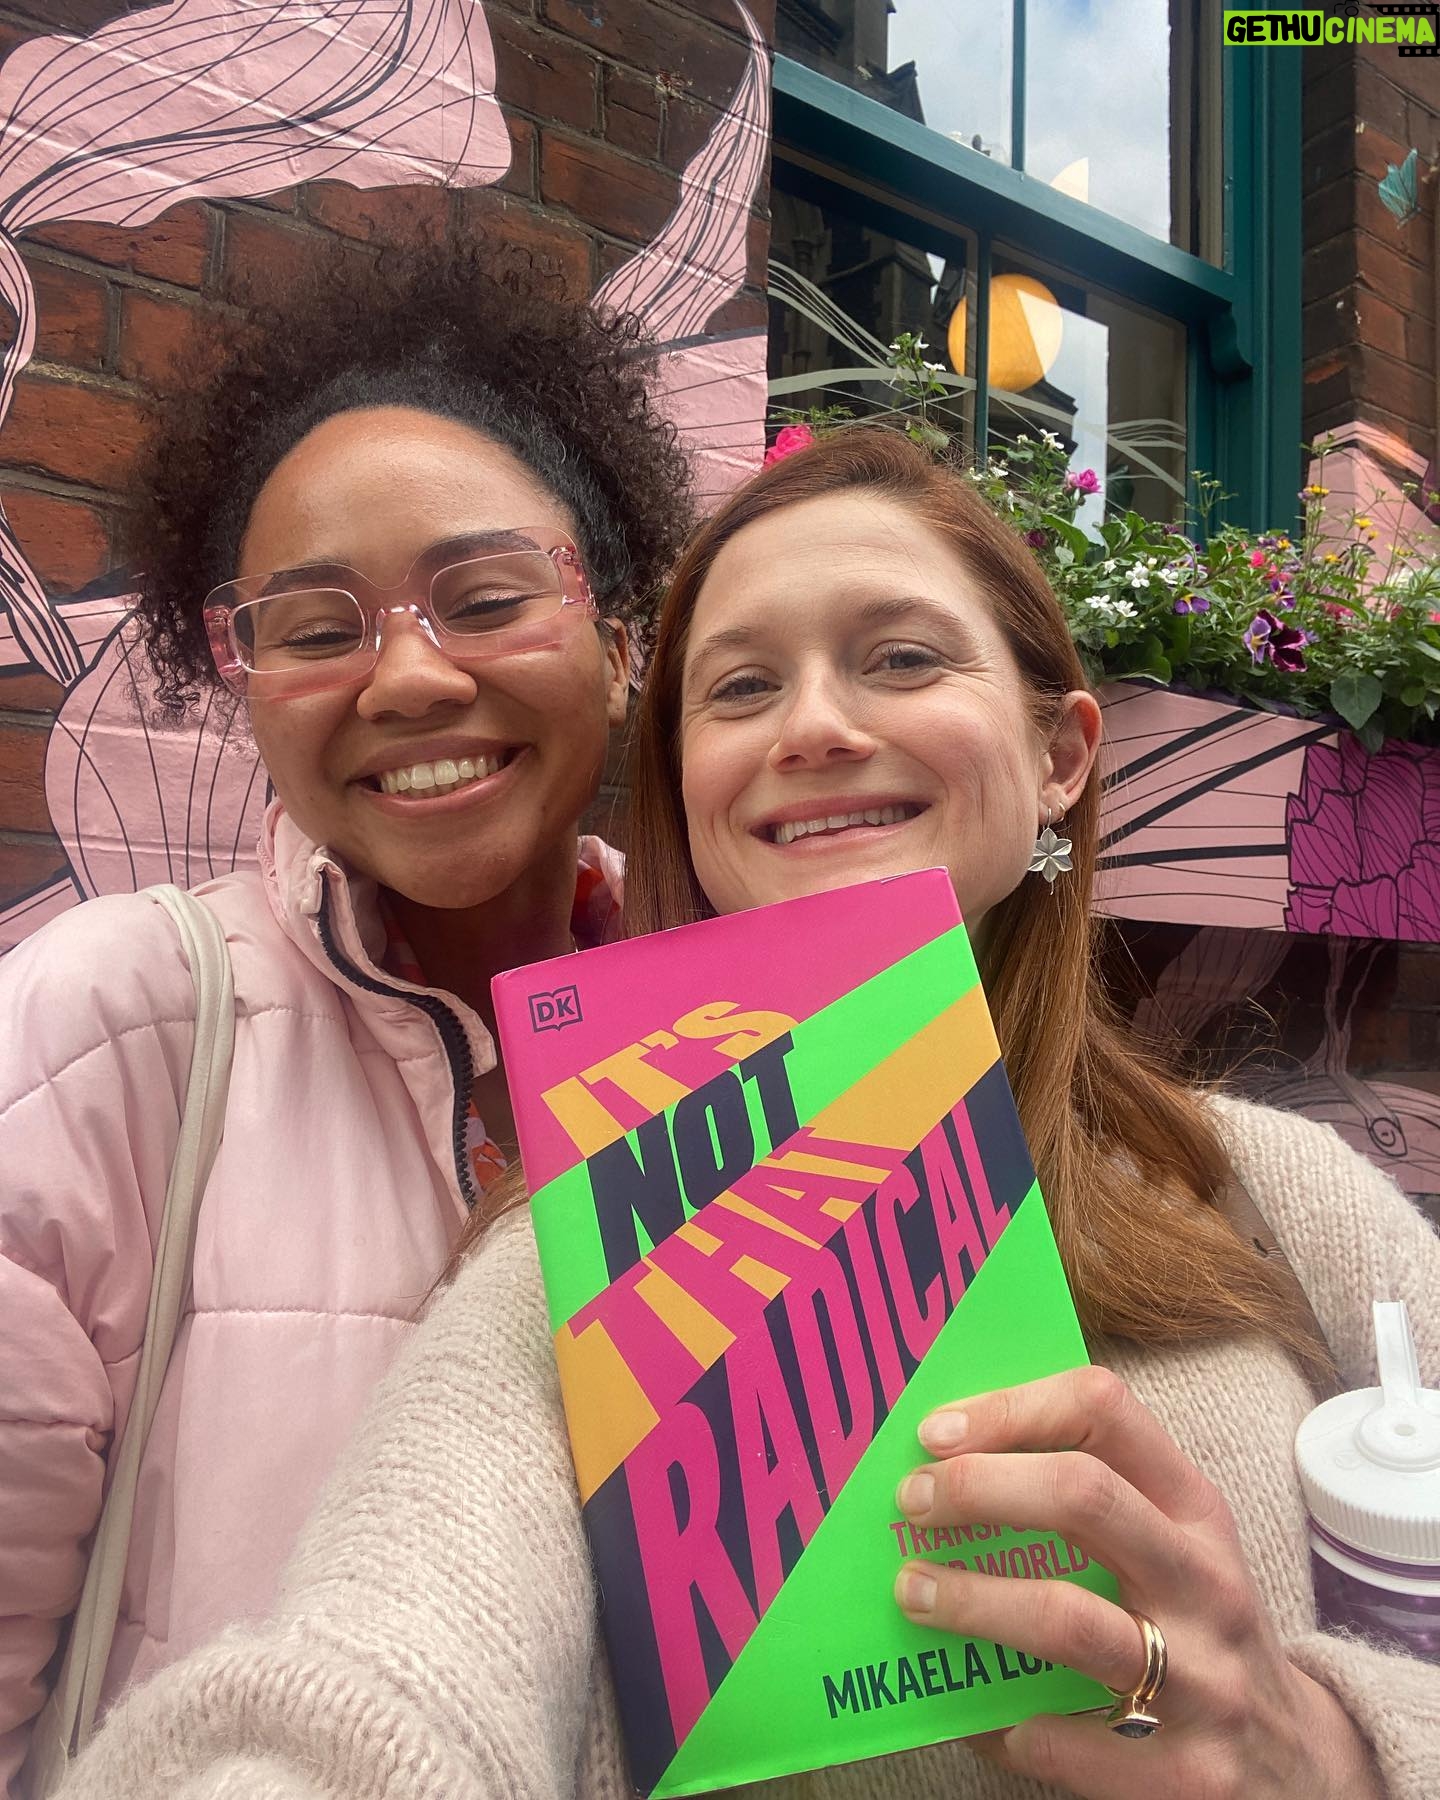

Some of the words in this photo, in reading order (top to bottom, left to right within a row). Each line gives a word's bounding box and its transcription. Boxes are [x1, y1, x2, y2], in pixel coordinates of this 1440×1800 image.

[536, 996, 575, 1022] DK
[541, 1001, 800, 1159] IT'S
[586, 1030, 801, 1286] NOT
[567, 1127, 918, 1420] THAT
[624, 1097, 1010, 1751] RADICAL
[975, 1540, 1089, 1579] WORLD
[822, 1642, 991, 1719] MIKAELA
